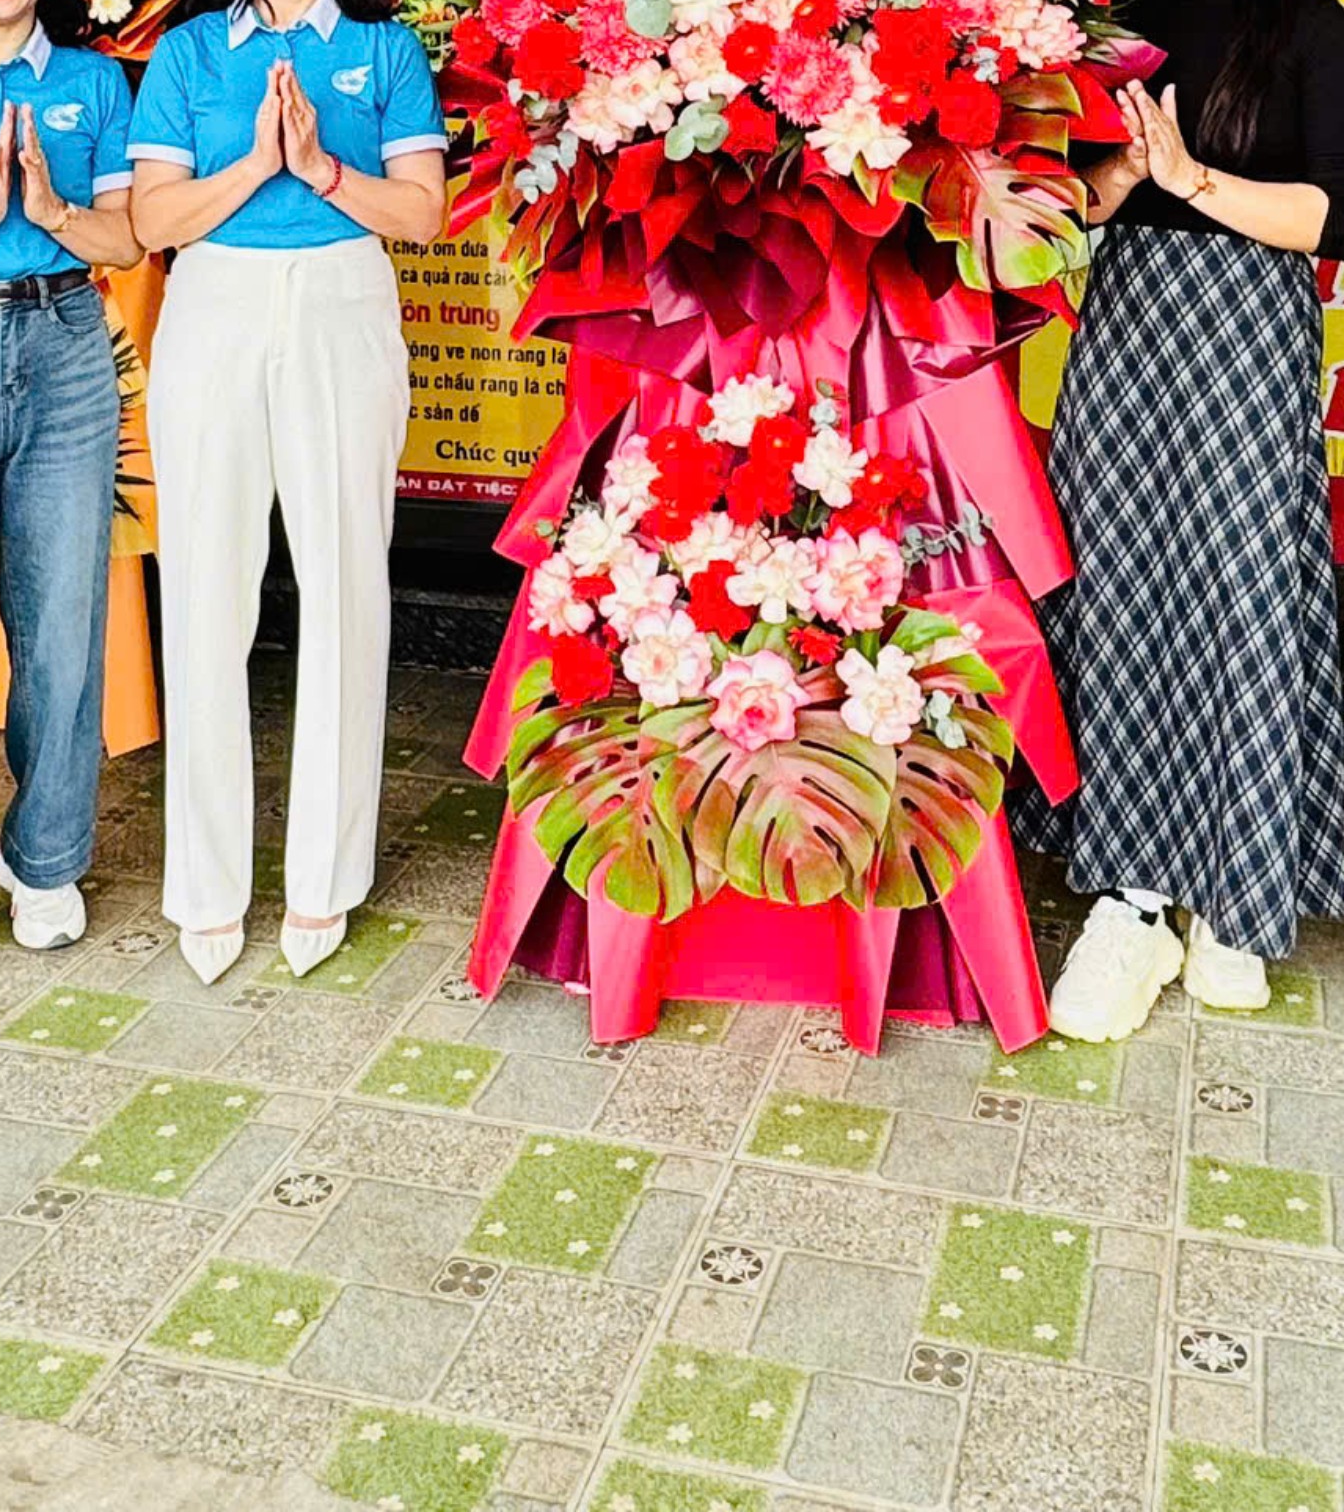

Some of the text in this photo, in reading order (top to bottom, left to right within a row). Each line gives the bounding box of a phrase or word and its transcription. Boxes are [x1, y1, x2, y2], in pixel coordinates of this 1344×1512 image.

[433, 241, 456, 256] om
[461, 239, 488, 257] dưa
[455, 270, 479, 285] rau
[401, 298, 500, 332] ôn trùng
[445, 345, 465, 360] ve
[471, 346, 501, 361] non
[508, 348, 545, 367] rang
[480, 378, 518, 397] rang
[435, 439, 496, 462] Chúc
